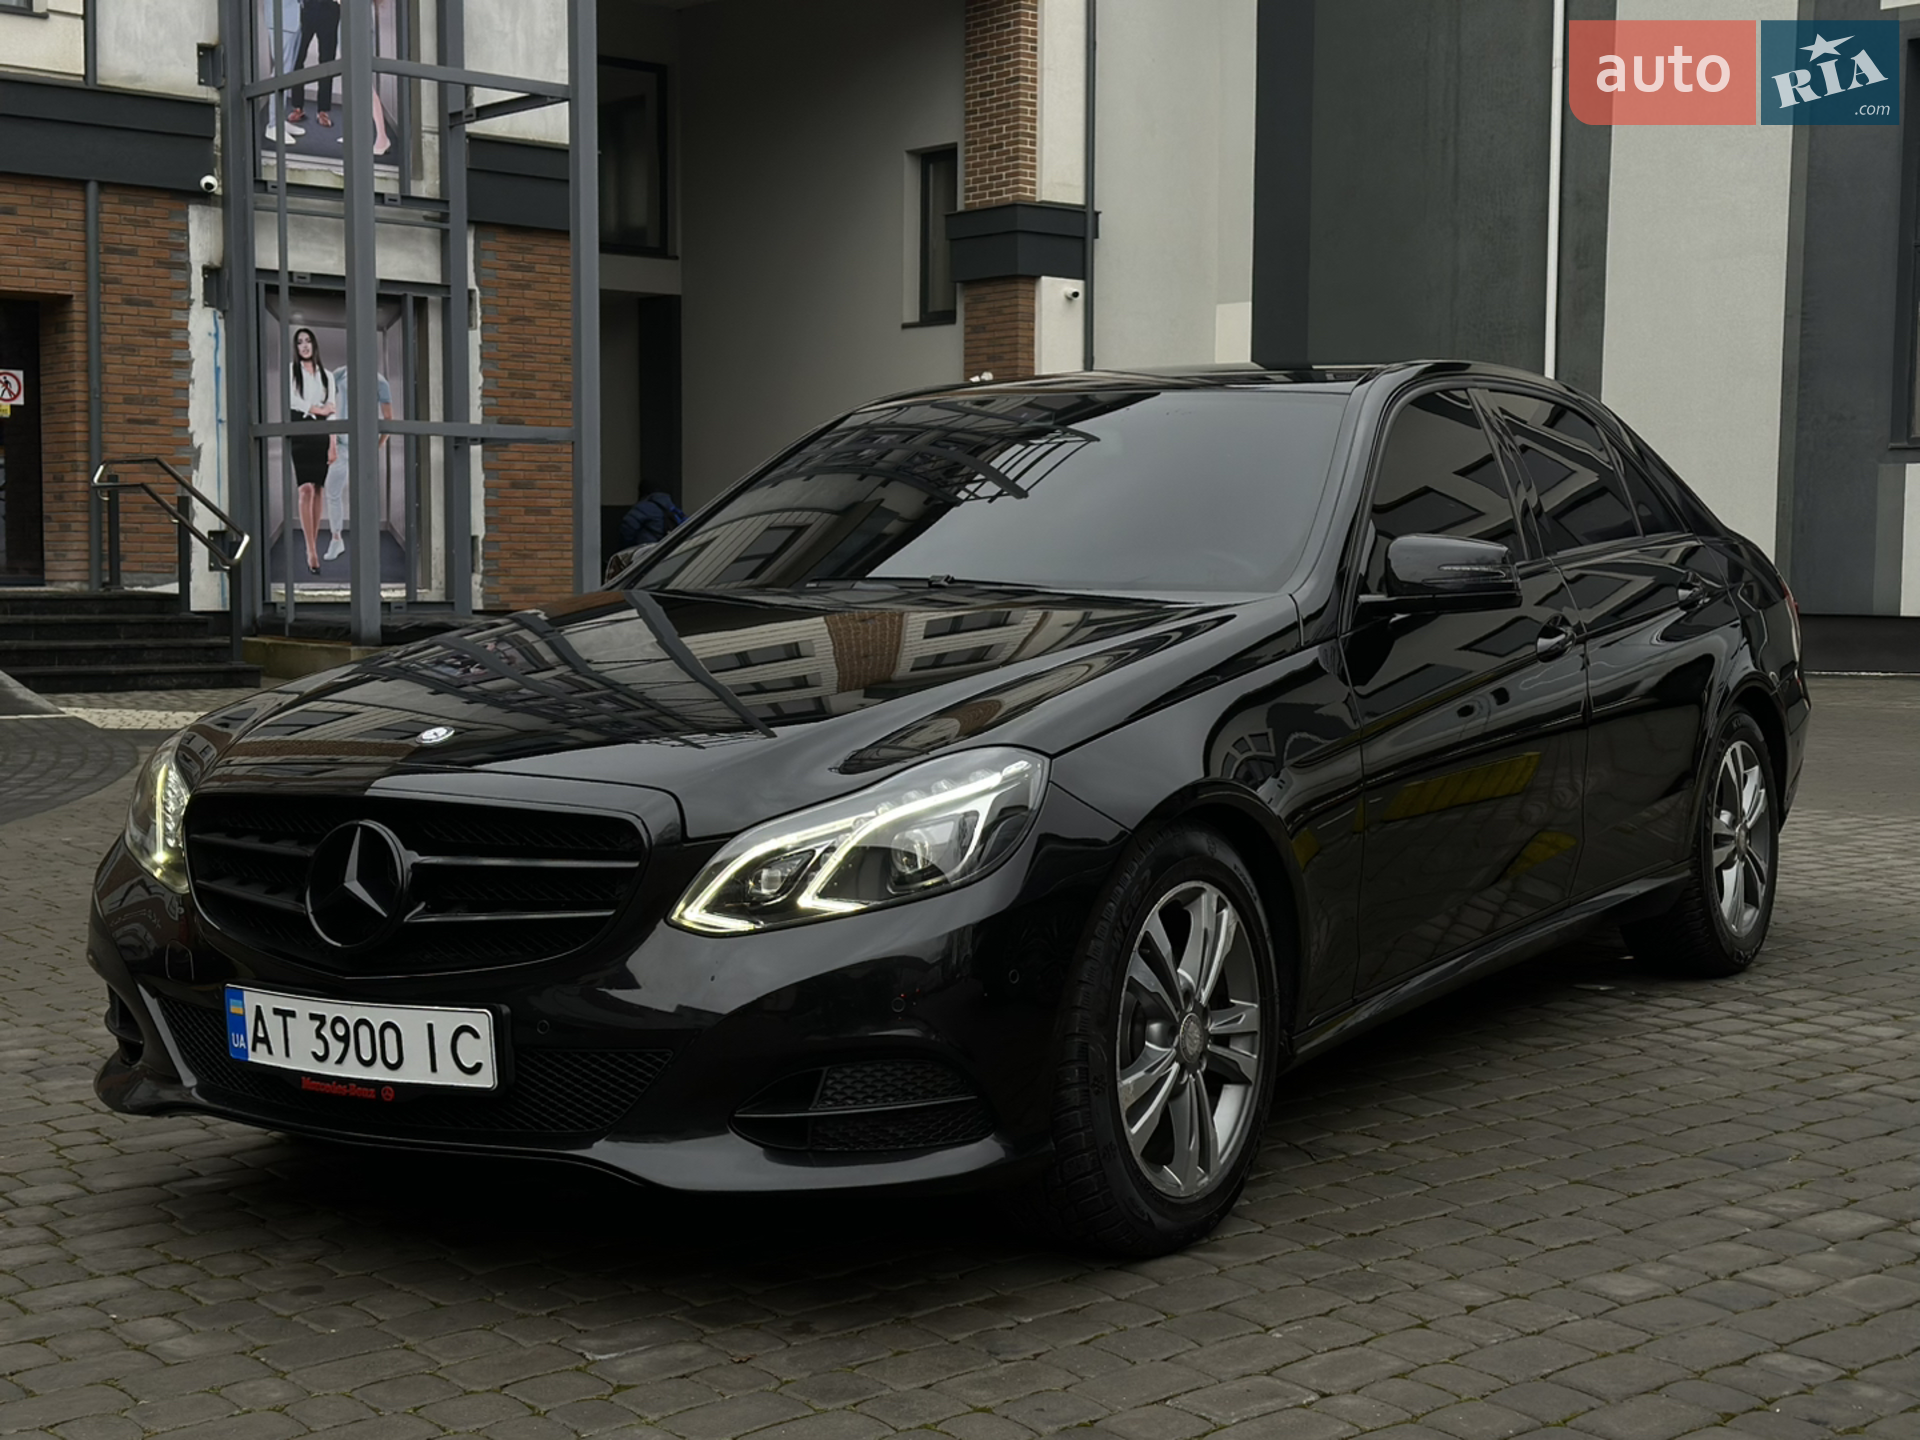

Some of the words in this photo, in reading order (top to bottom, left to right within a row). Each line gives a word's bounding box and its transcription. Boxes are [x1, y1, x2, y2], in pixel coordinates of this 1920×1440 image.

[231, 1032, 246, 1049] UA
[251, 1004, 296, 1058] AT
[309, 1012, 404, 1071] 3900
[426, 1022, 483, 1075] IC
[301, 1076, 376, 1099] Mercedes-Benz
